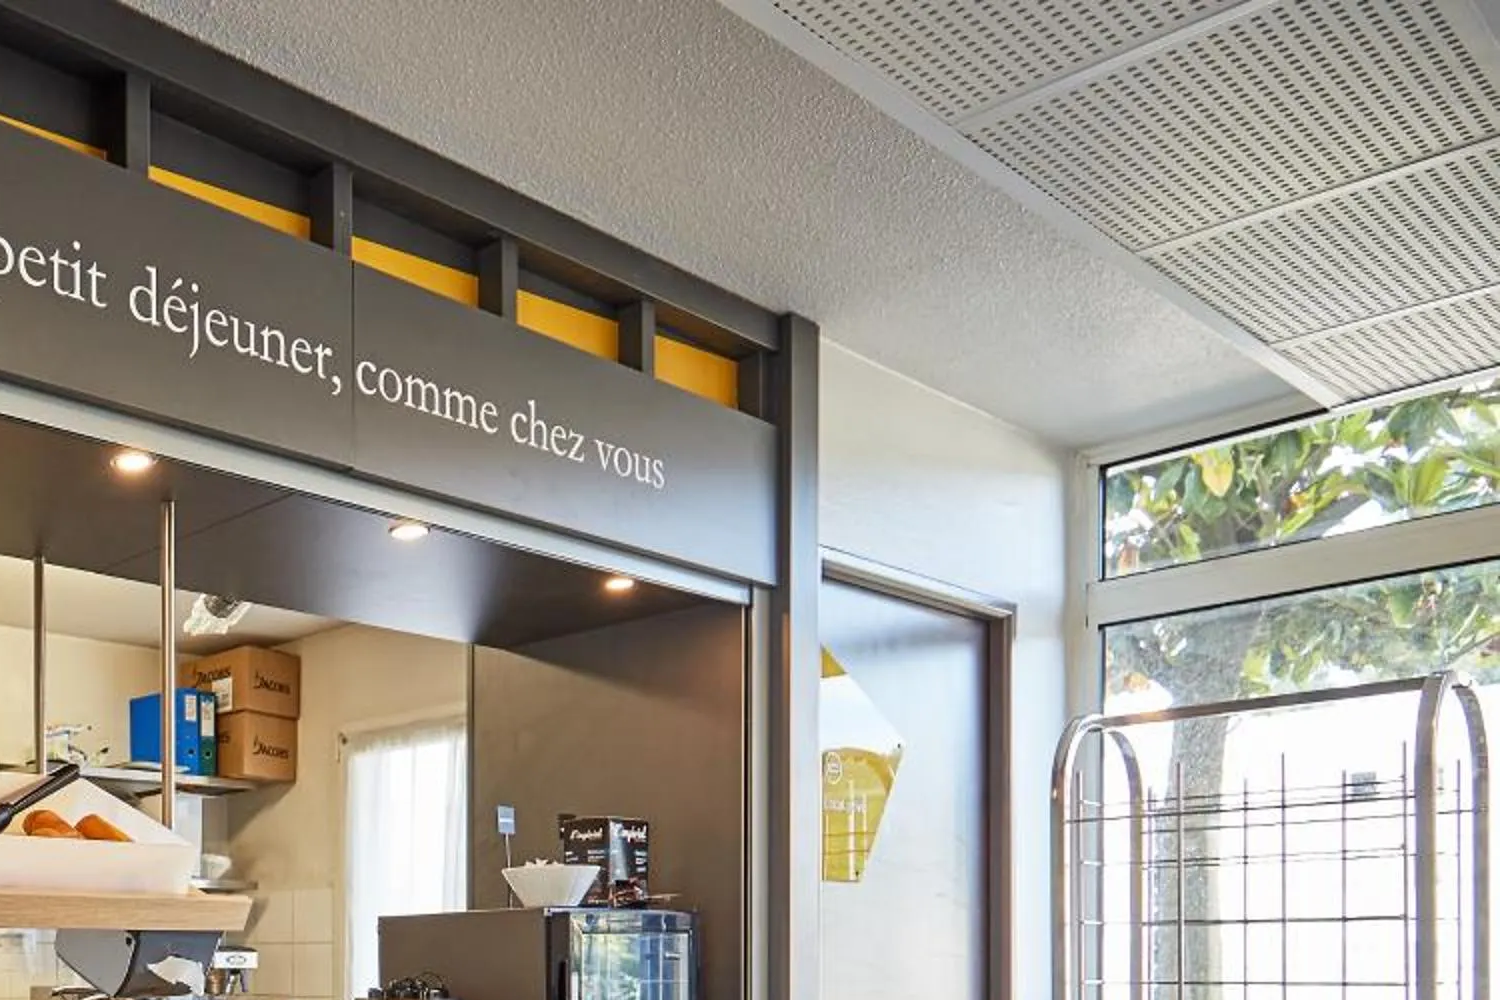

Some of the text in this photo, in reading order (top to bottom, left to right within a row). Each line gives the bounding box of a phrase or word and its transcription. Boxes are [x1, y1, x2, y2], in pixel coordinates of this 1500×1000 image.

[129, 266, 342, 396] déjeuner,
[356, 361, 499, 434] comme
[509, 400, 586, 463] chez
[594, 438, 665, 489] vous
